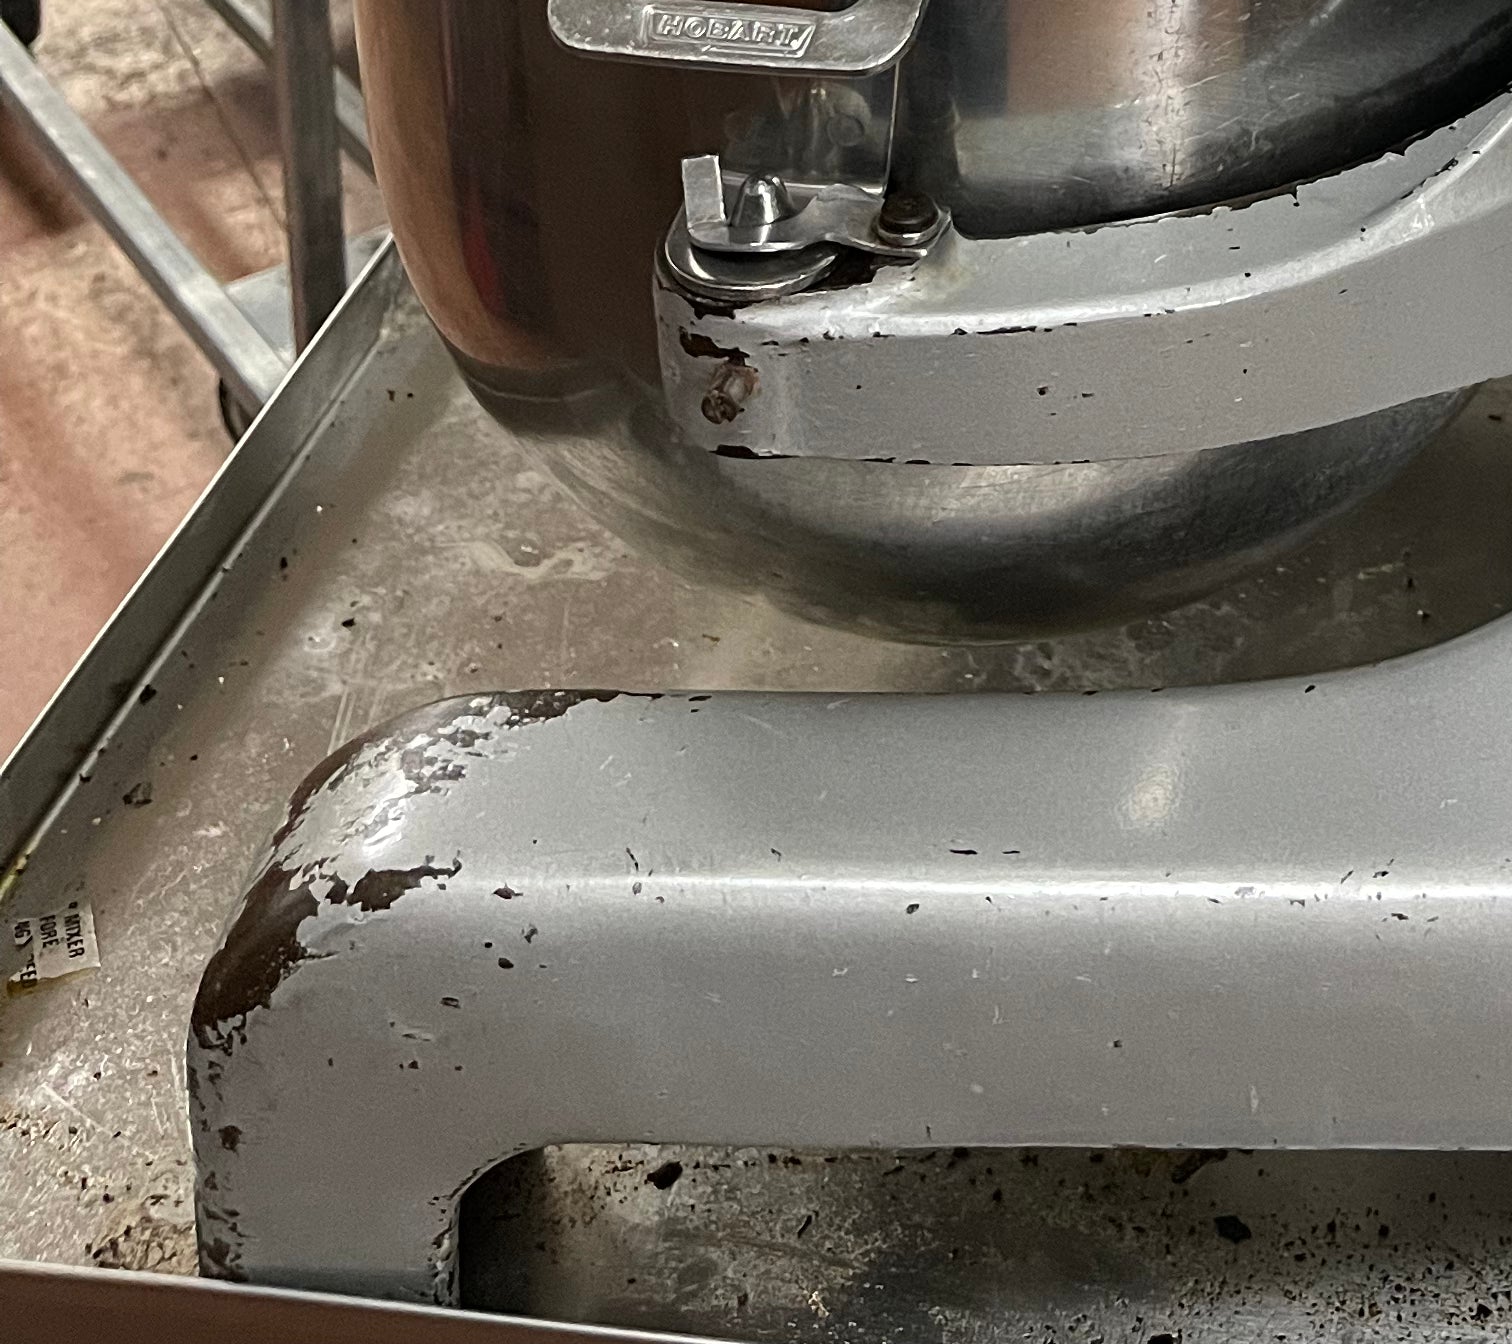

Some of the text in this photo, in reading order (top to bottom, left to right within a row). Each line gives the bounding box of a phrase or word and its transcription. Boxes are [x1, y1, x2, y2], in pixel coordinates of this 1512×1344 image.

[657, 14, 799, 45] HOBART
[39, 914, 59, 949] FORE
[64, 913, 85, 959] MIXER
